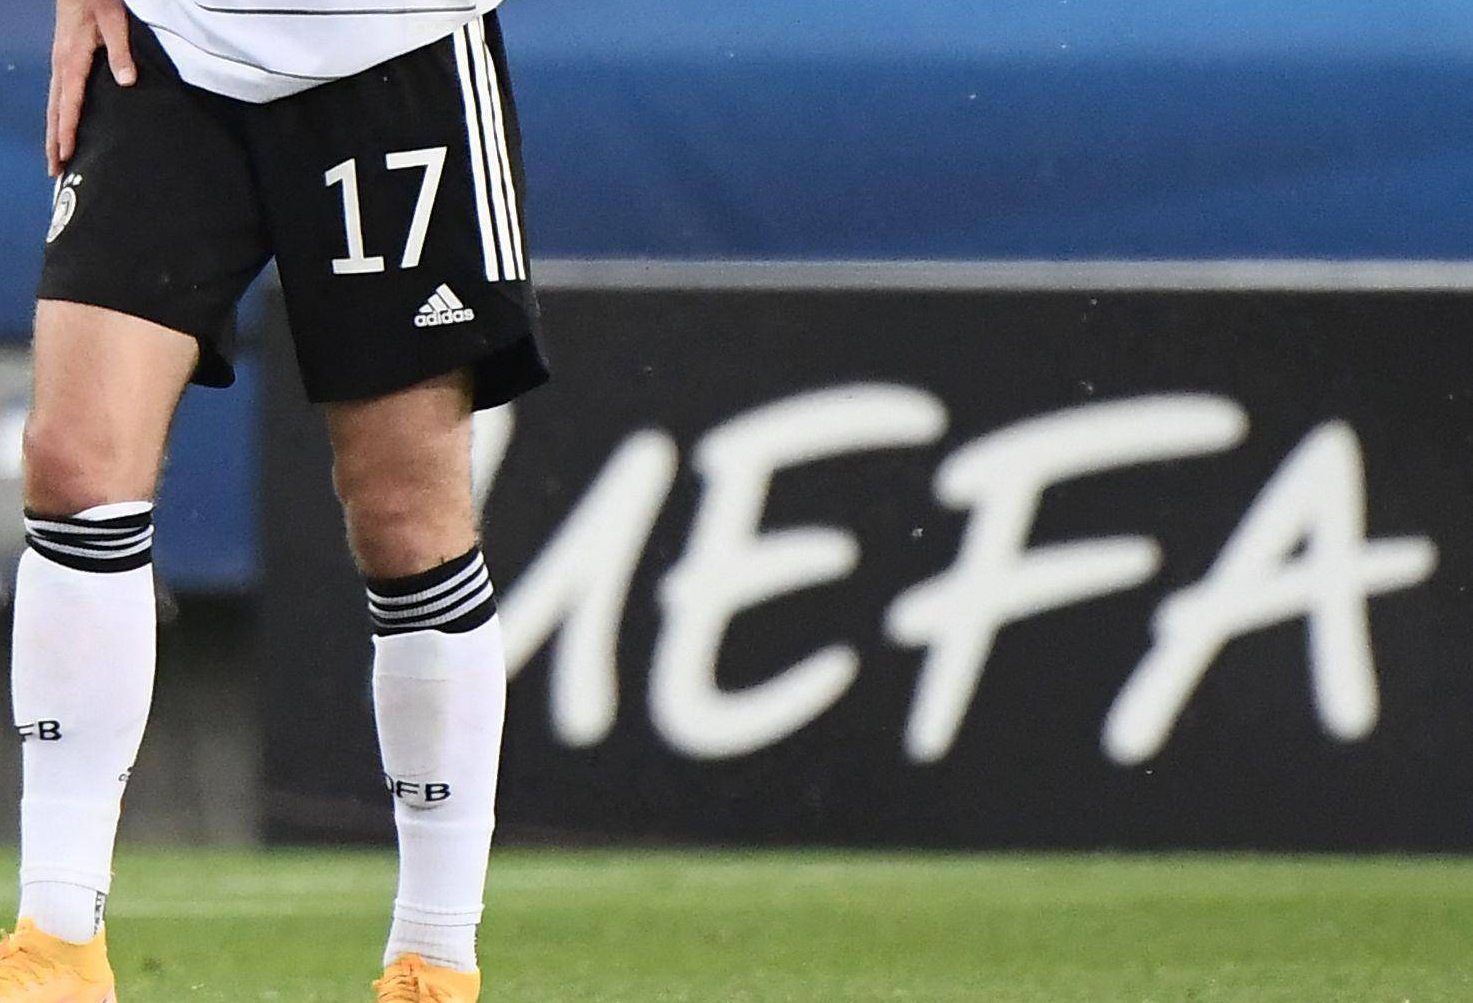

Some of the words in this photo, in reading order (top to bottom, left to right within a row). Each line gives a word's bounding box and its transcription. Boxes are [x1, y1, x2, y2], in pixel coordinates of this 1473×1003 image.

[325, 146, 448, 274] 17
[414, 308, 474, 327] adidas
[15, 720, 62, 742] FB
